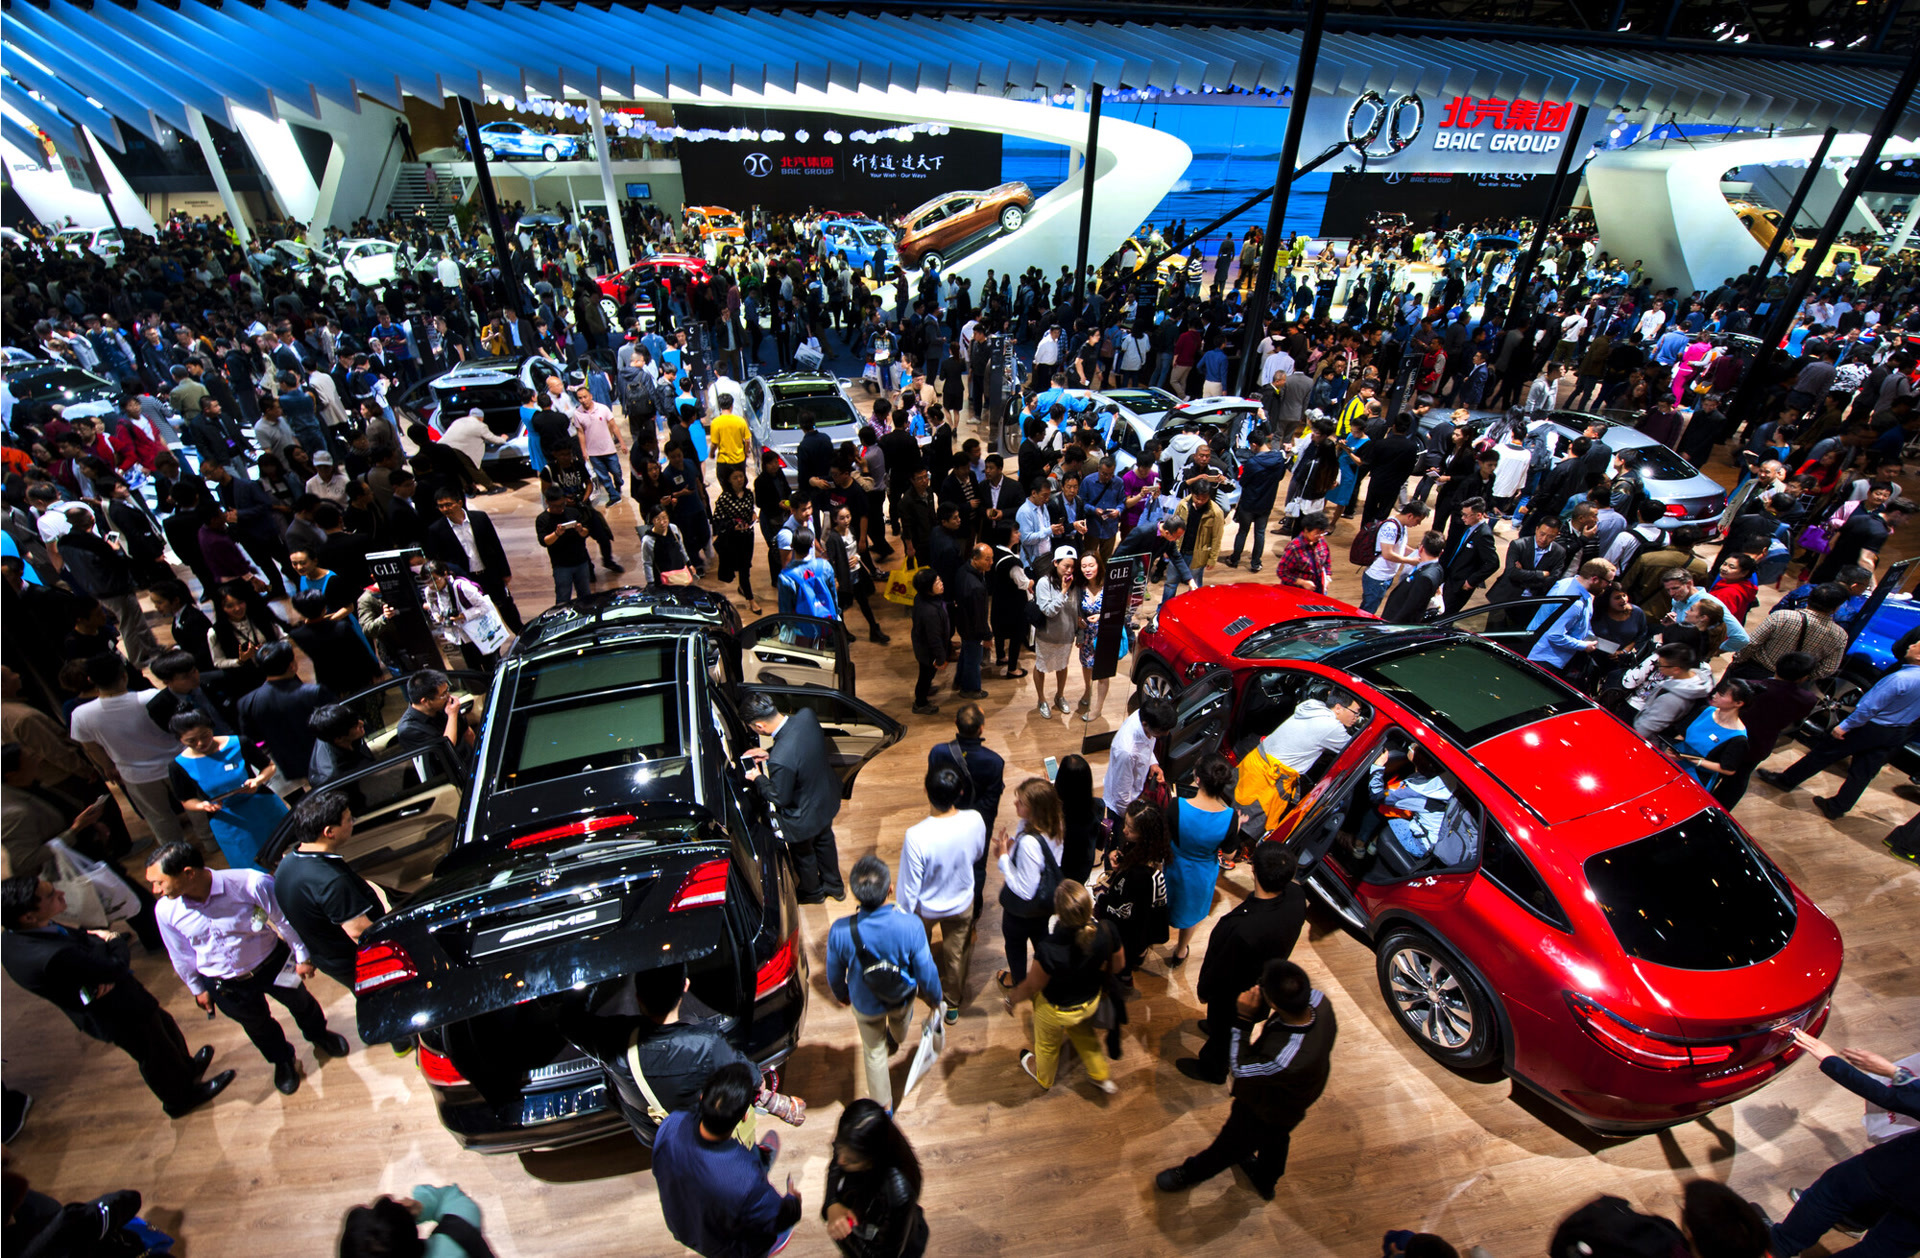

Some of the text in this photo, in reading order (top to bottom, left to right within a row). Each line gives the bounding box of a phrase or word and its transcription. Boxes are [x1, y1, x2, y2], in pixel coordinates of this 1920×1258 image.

[1440, 96, 1573, 132] 北汽集团
[1433, 132, 1560, 153] BAIC GROUP
[780, 156, 834, 168] 北汽集团
[374, 562, 400, 576] GLE
[1109, 566, 1129, 580] GLE
